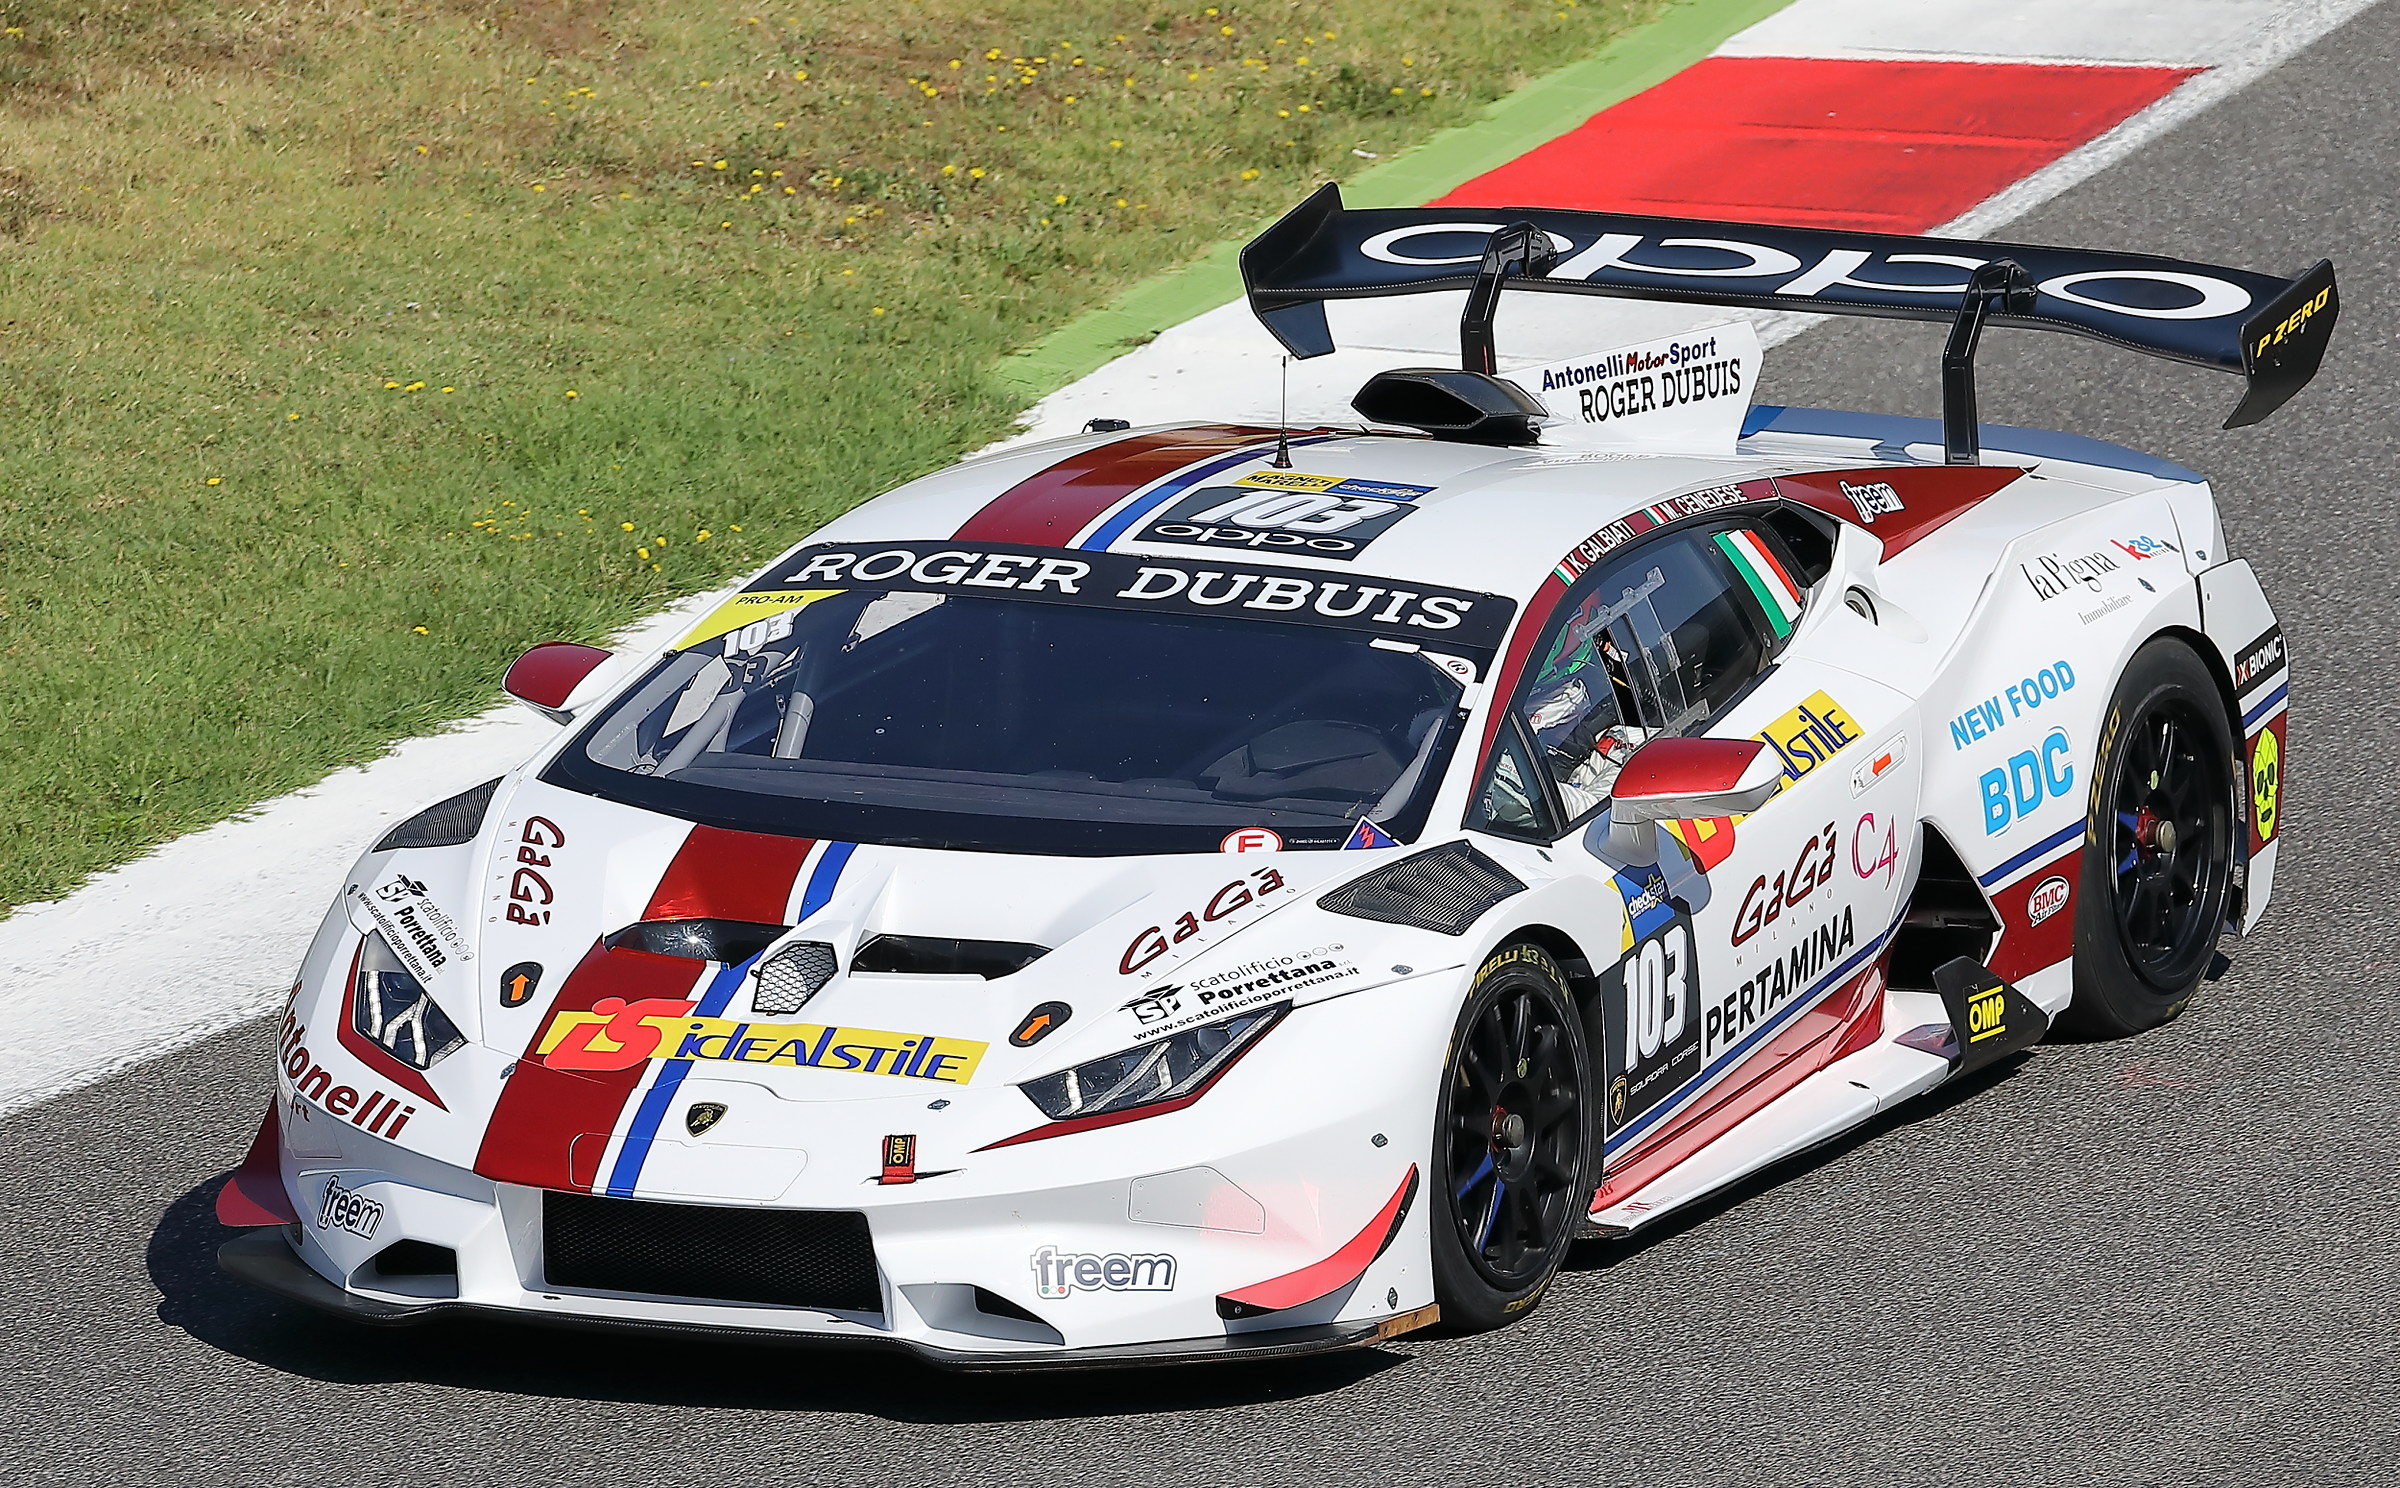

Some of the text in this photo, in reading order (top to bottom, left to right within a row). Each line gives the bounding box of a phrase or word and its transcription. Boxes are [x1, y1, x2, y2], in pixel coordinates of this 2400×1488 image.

[2256, 287, 2330, 358] P ZERO
[1542, 353, 1624, 392] Antonelli
[1579, 357, 1741, 424] ROGER DUBUIS
[1187, 490, 1400, 533] 103
[1660, 484, 1748, 521] M. CENEDESE
[1841, 482, 1904, 518] freem
[1579, 519, 1636, 564] GALBIATI
[735, 595, 804, 605] PRO-AM
[784, 552, 1473, 631] ROGER DUBUIS
[2078, 594, 2134, 625] Immobiliare
[723, 611, 795, 658] 103
[1949, 660, 2076, 751] NEW FOOD
[1979, 730, 2074, 837] BDC
[1852, 812, 1899, 890] C4
[417, 898, 458, 941] scatolificio
[2033, 884, 2065, 914] BMC
[394, 906, 447, 969] Porrettana
[1190, 957, 1293, 992] scatolificio
[1197, 958, 1336, 1006] Porrettana
[1706, 904, 1854, 1058] PERTAMINA
[1133, 966, 1360, 1041] www.scatolificioporrettana.it
[1622, 924, 1687, 1074] 103
[1969, 994, 2005, 1033] OMP
[1671, 1041, 1699, 1069] CORSE
[892, 1137, 905, 1164] OMP
[318, 1176, 383, 1239] freem
[1033, 1249, 1175, 1290] freem
